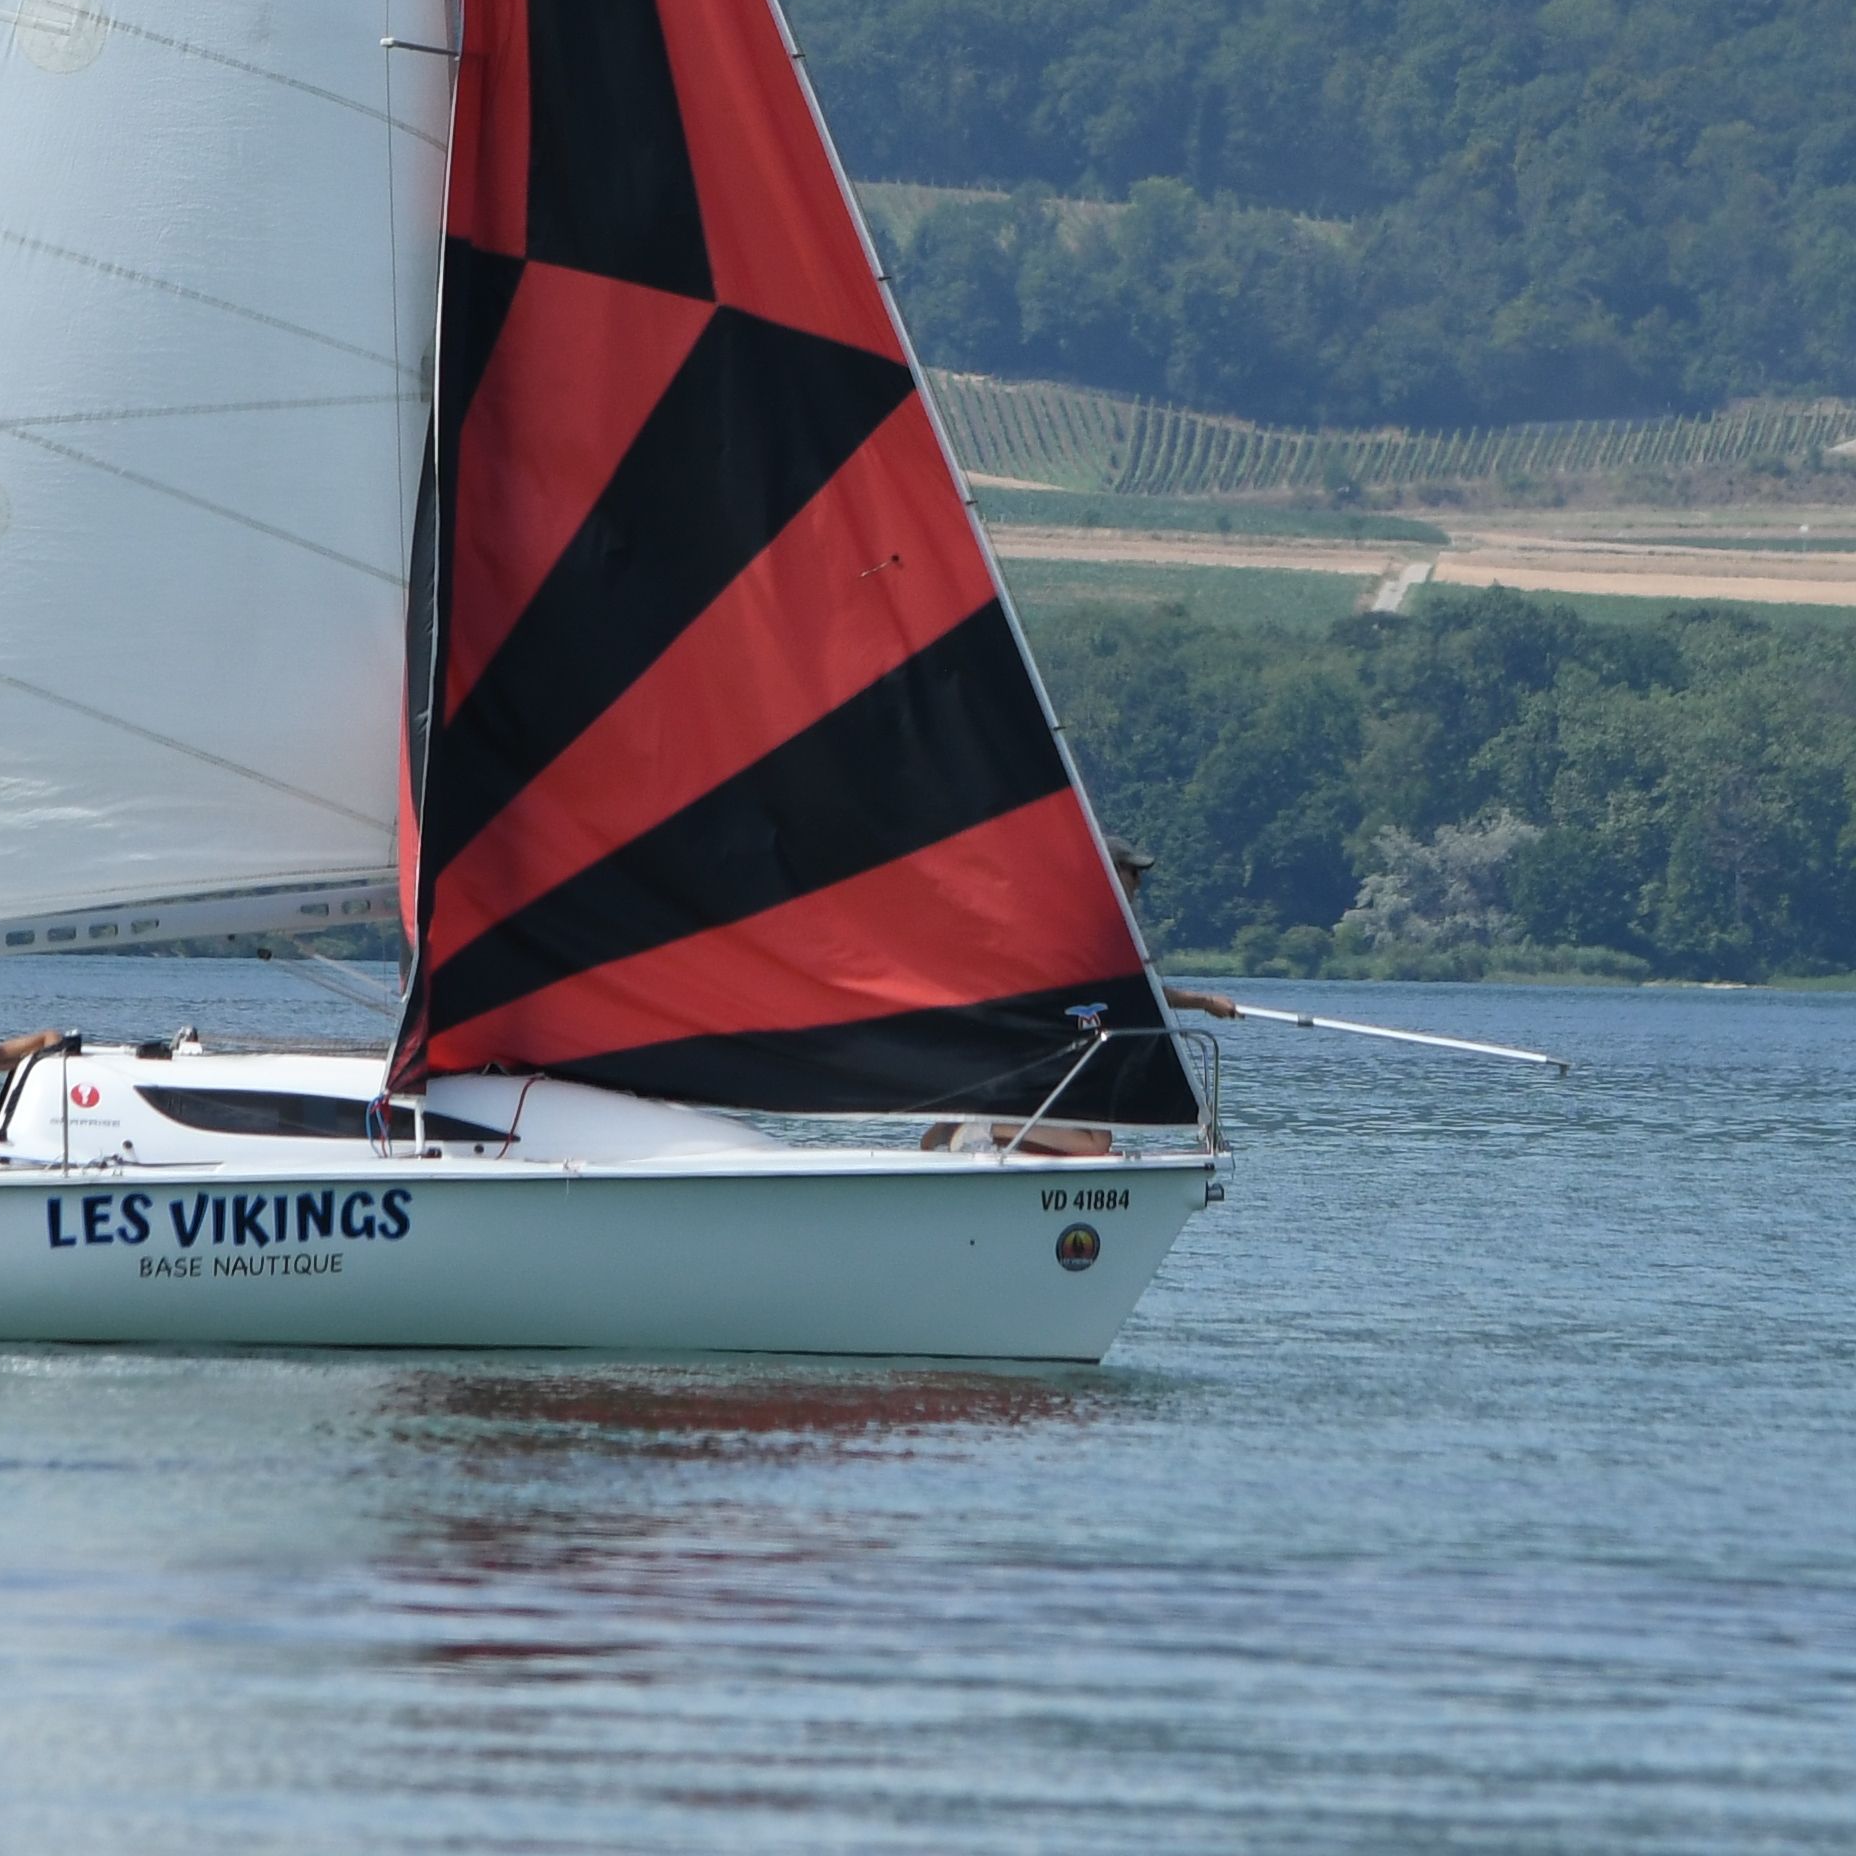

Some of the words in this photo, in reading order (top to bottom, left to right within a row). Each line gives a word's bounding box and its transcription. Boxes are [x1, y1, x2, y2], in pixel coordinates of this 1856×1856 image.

[1041, 1189, 1068, 1211] VD
[1073, 1188, 1130, 1211] 41884
[47, 1192, 154, 1249] LES
[169, 1188, 414, 1249] VIKINGS
[139, 1255, 203, 1279] BASE
[213, 1252, 344, 1277] NAUTIQUE
